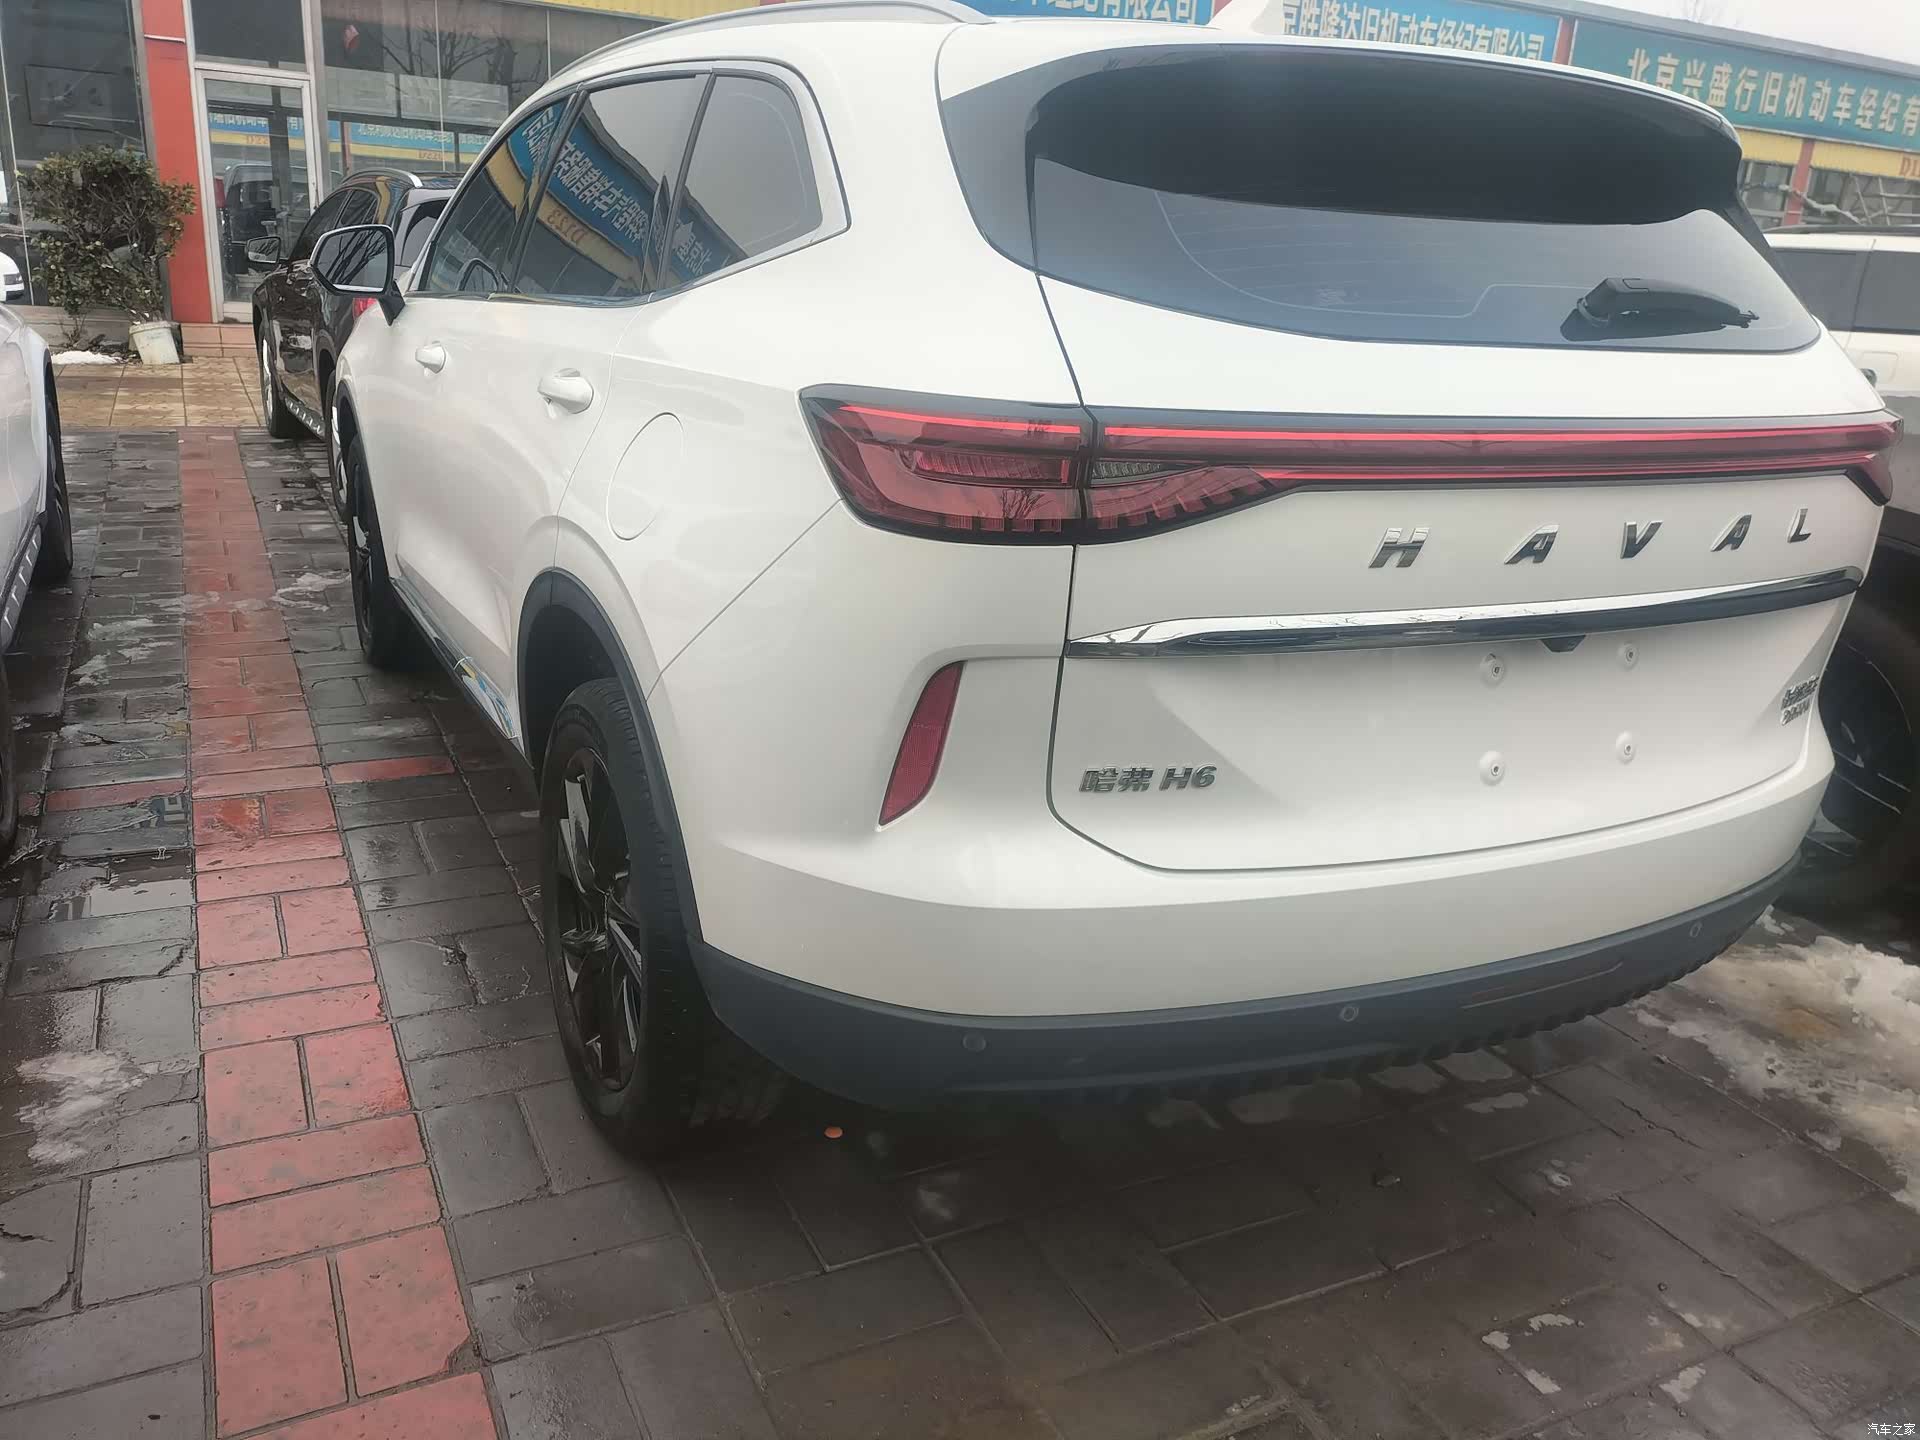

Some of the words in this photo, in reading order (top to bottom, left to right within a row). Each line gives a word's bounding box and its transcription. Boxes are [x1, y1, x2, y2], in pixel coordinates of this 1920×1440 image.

[1369, 508, 1811, 568] HAVAL
[1079, 766, 1154, 792] 哈弗
[1159, 764, 1217, 791] H6
